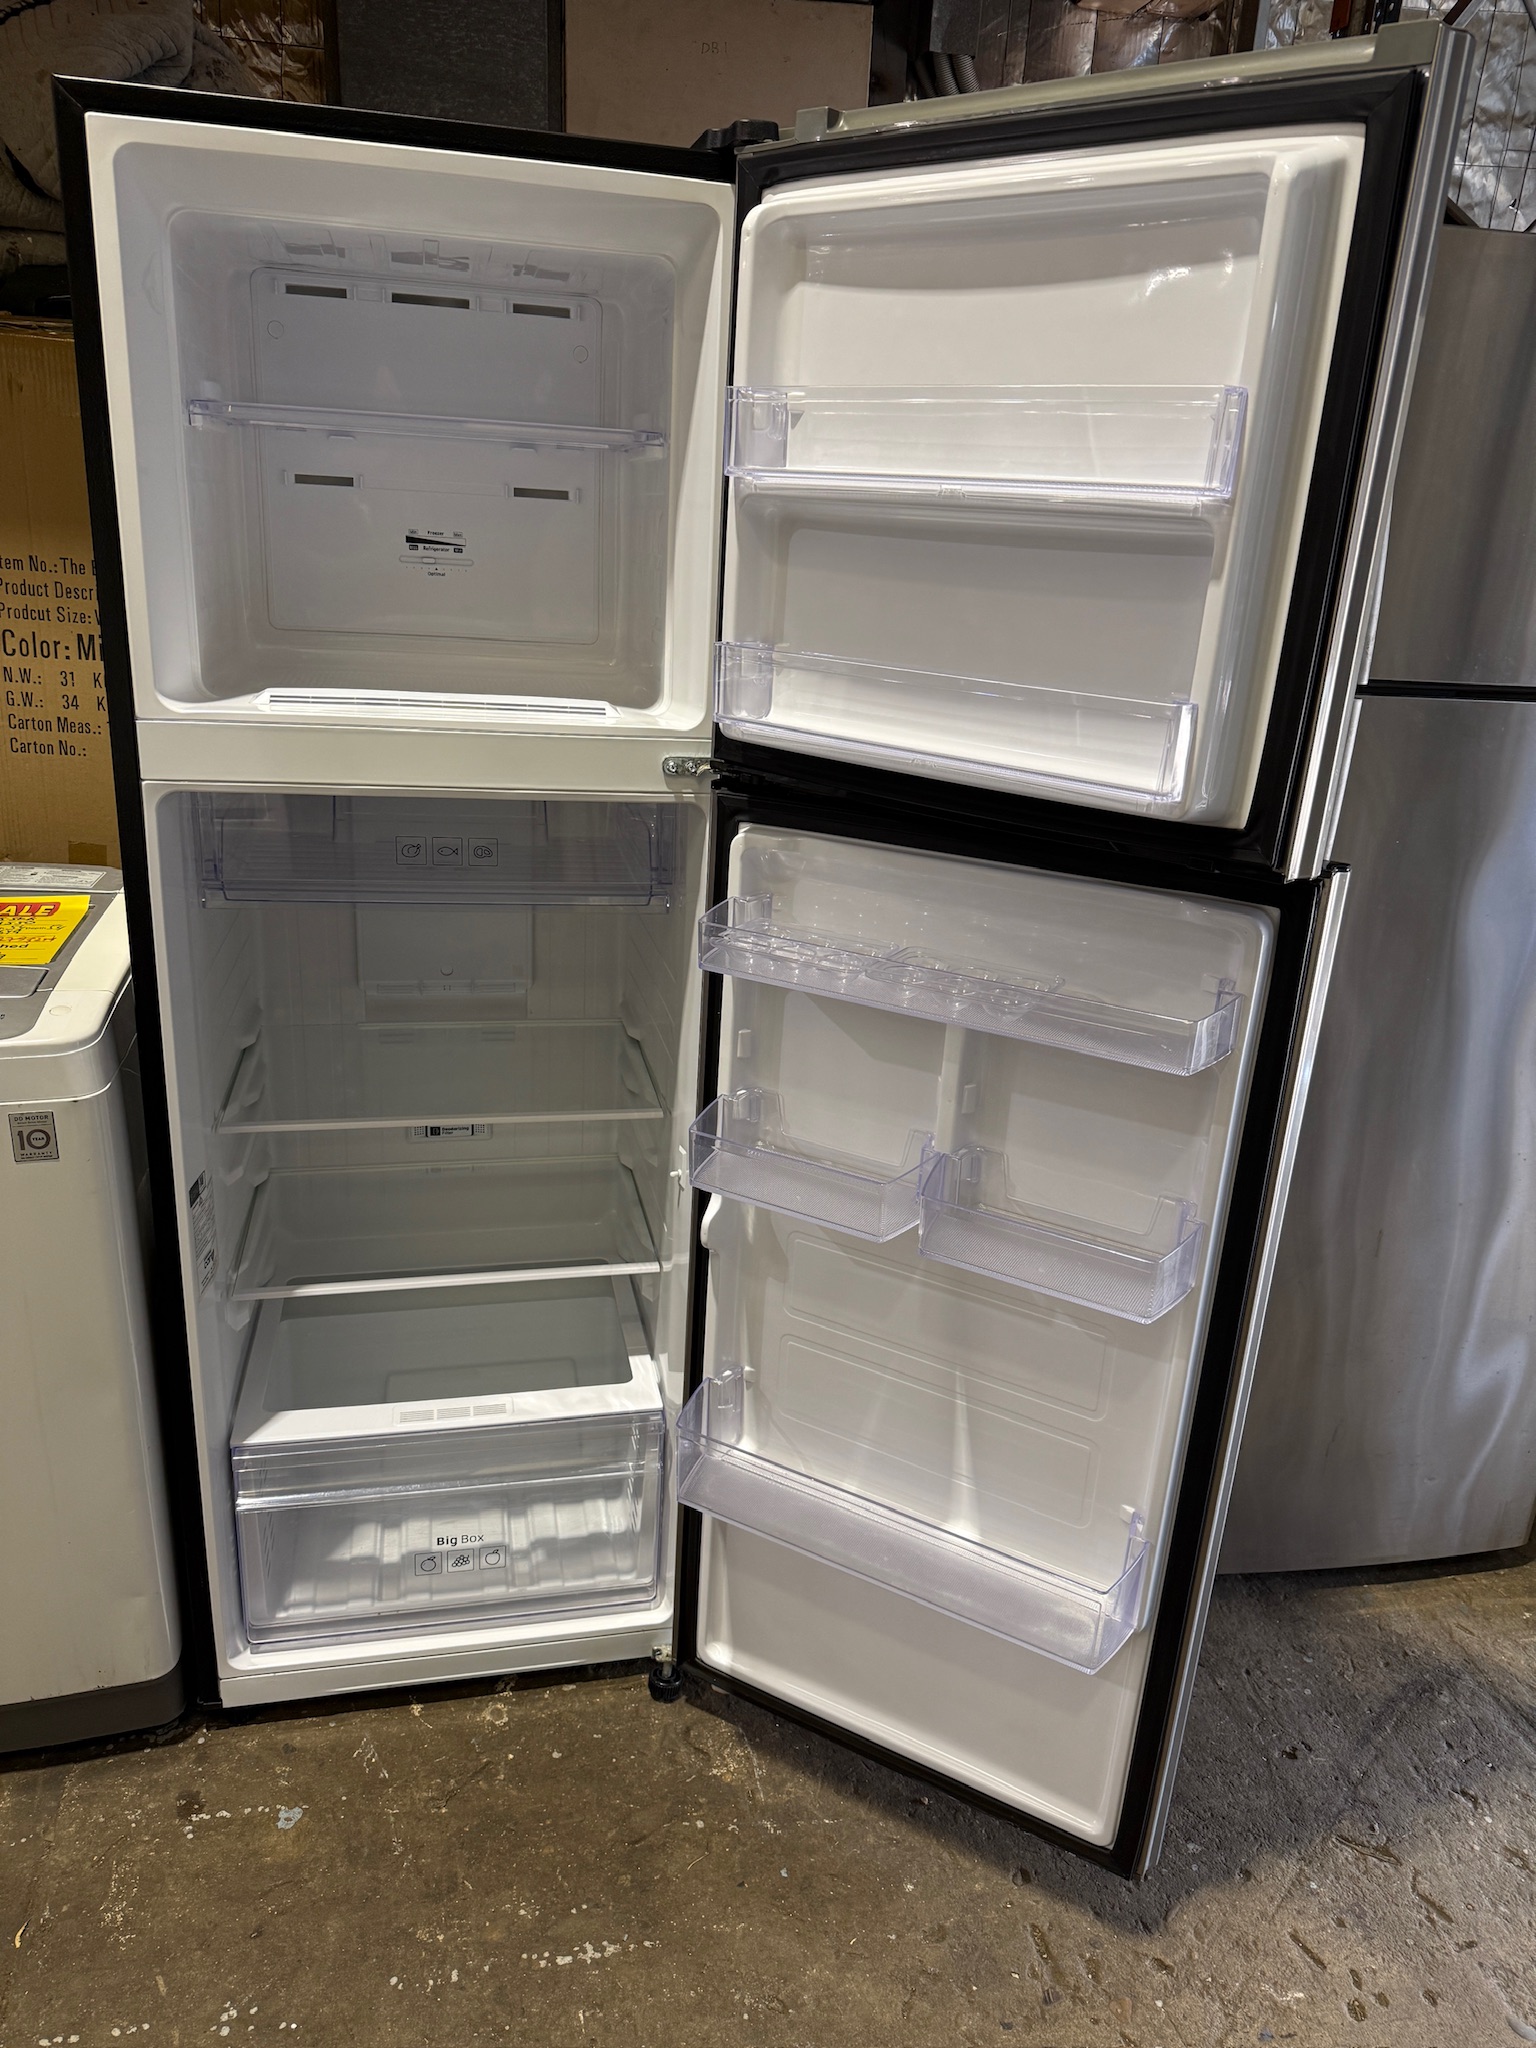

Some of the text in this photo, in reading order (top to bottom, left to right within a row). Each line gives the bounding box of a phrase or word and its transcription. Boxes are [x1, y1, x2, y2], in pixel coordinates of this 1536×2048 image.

[54, 581, 98, 601] Descr
[57, 606, 92, 625] Size:
[2, 629, 71, 660] Color:
[3, 666, 42, 685] N.W.:
[6, 690, 44, 708] G.W.:
[62, 694, 80, 711] 34
[8, 713, 102, 736] Carton Meas.:
[10, 737, 87, 757] Carton No.:
[17, 1129, 51, 1150] 10
[436, 1535, 484, 1547] Big Box
